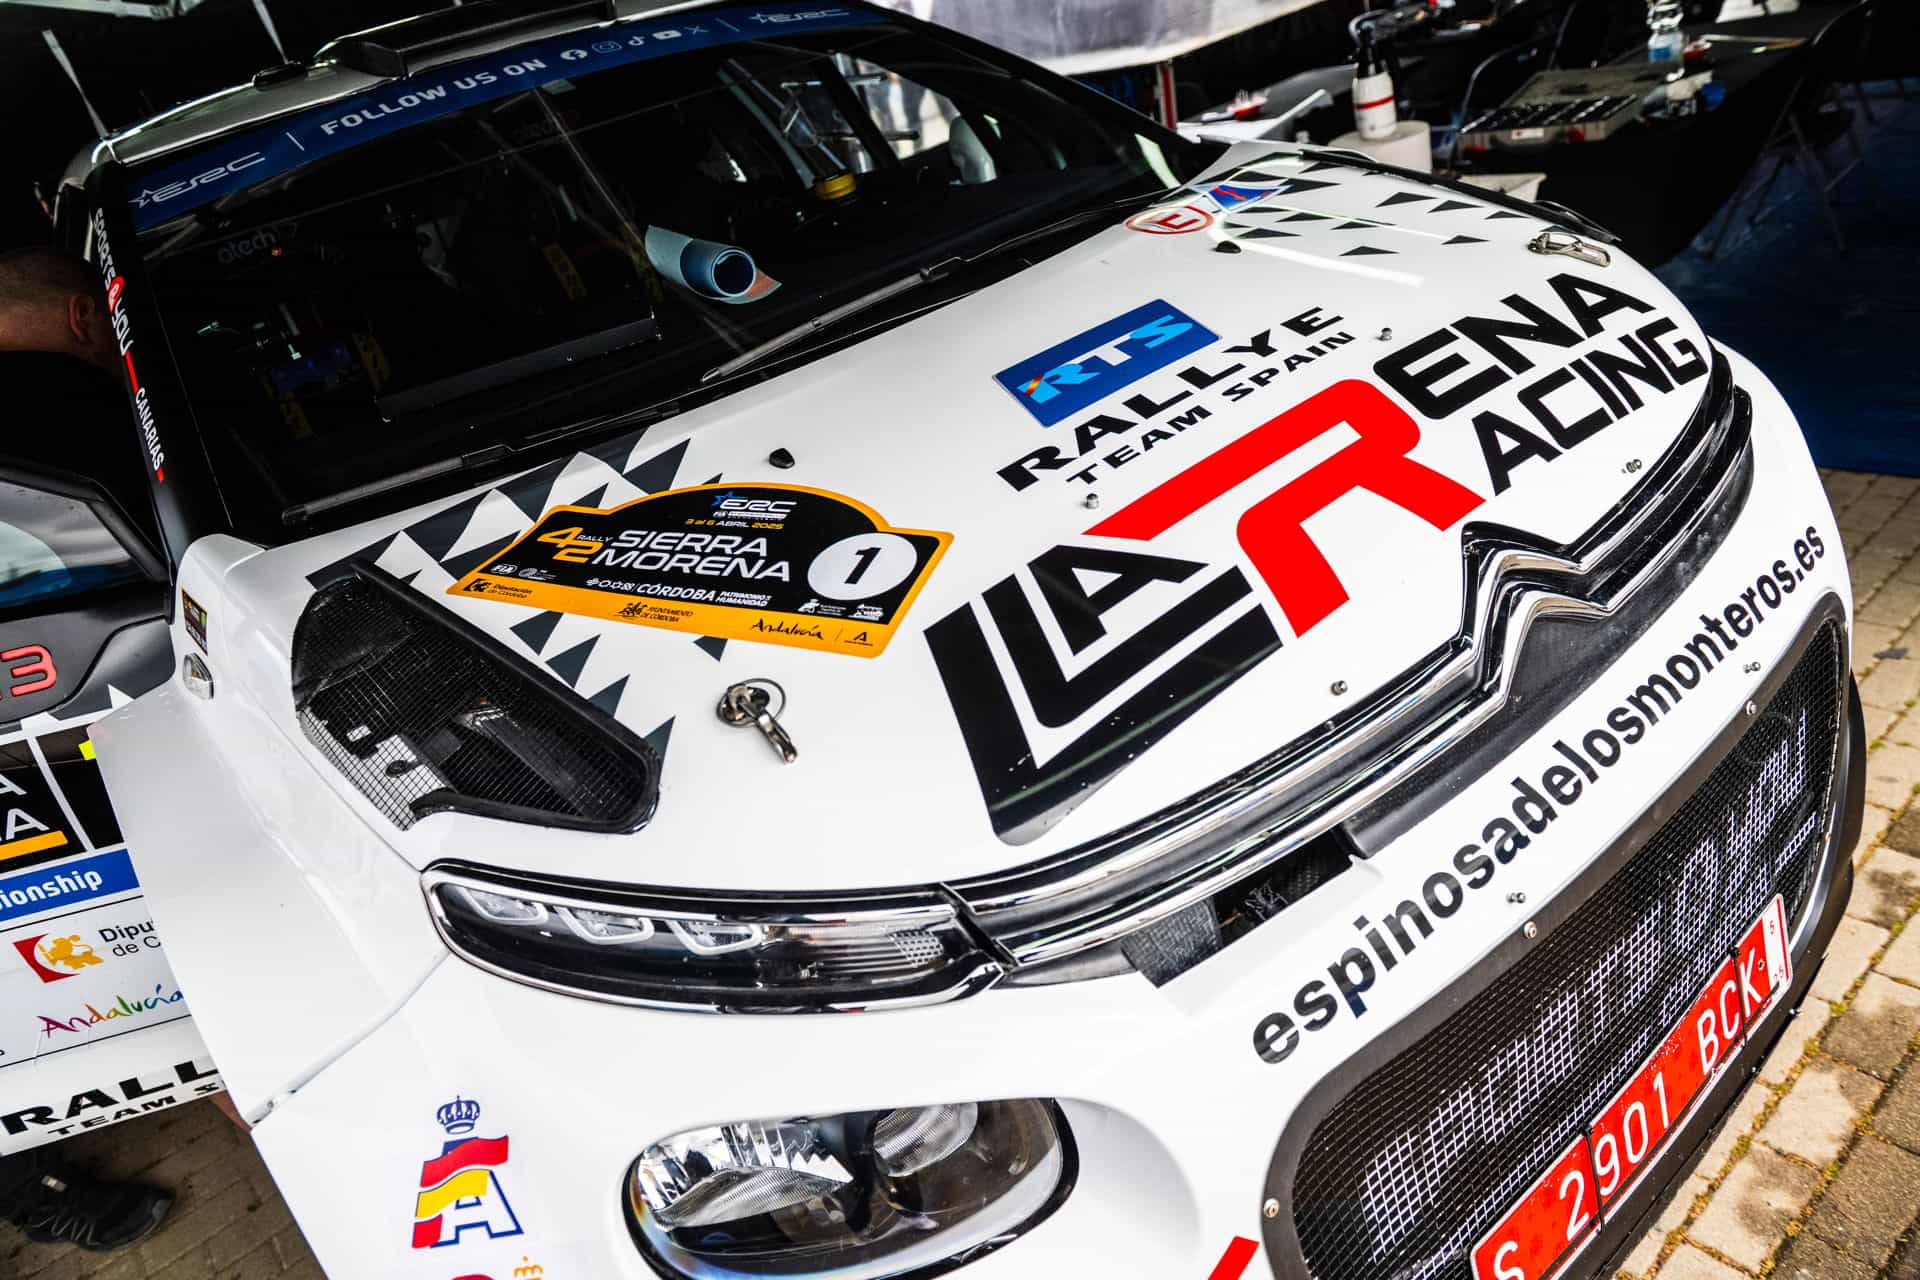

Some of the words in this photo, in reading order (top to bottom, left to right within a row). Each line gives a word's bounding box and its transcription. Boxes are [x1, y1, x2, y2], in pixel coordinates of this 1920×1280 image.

[320, 85, 447, 136] FOLLOW
[453, 71, 498, 91] US
[503, 58, 548, 77] ON
[1017, 314, 1194, 404] RTS
[996, 306, 1345, 492] RALLYE
[1066, 405, 1214, 485] TEAM
[1222, 331, 1356, 402] SPAIN
[135, 386, 165, 471] CANARIAS
[716, 520, 749, 528] ABRIL
[751, 522, 784, 530] 2025
[719, 498, 798, 513] ERC
[575, 534, 613, 543] RALLY
[611, 530, 768, 557] SIERRA
[591, 548, 791, 583] MORENA
[844, 546, 882, 585] 1
[637, 583, 716, 602] CÓRDOBA
[1252, 525, 1826, 1065] espinosadelosmonteros.es
[98, 917, 153, 946] Dipu
[112, 940, 139, 957] de
[37, 984, 184, 1038] Andalucía
[1559, 1071, 1672, 1242] 2901
[1695, 947, 1763, 1077] BCK
[47, 1096, 177, 1135] TEAM
